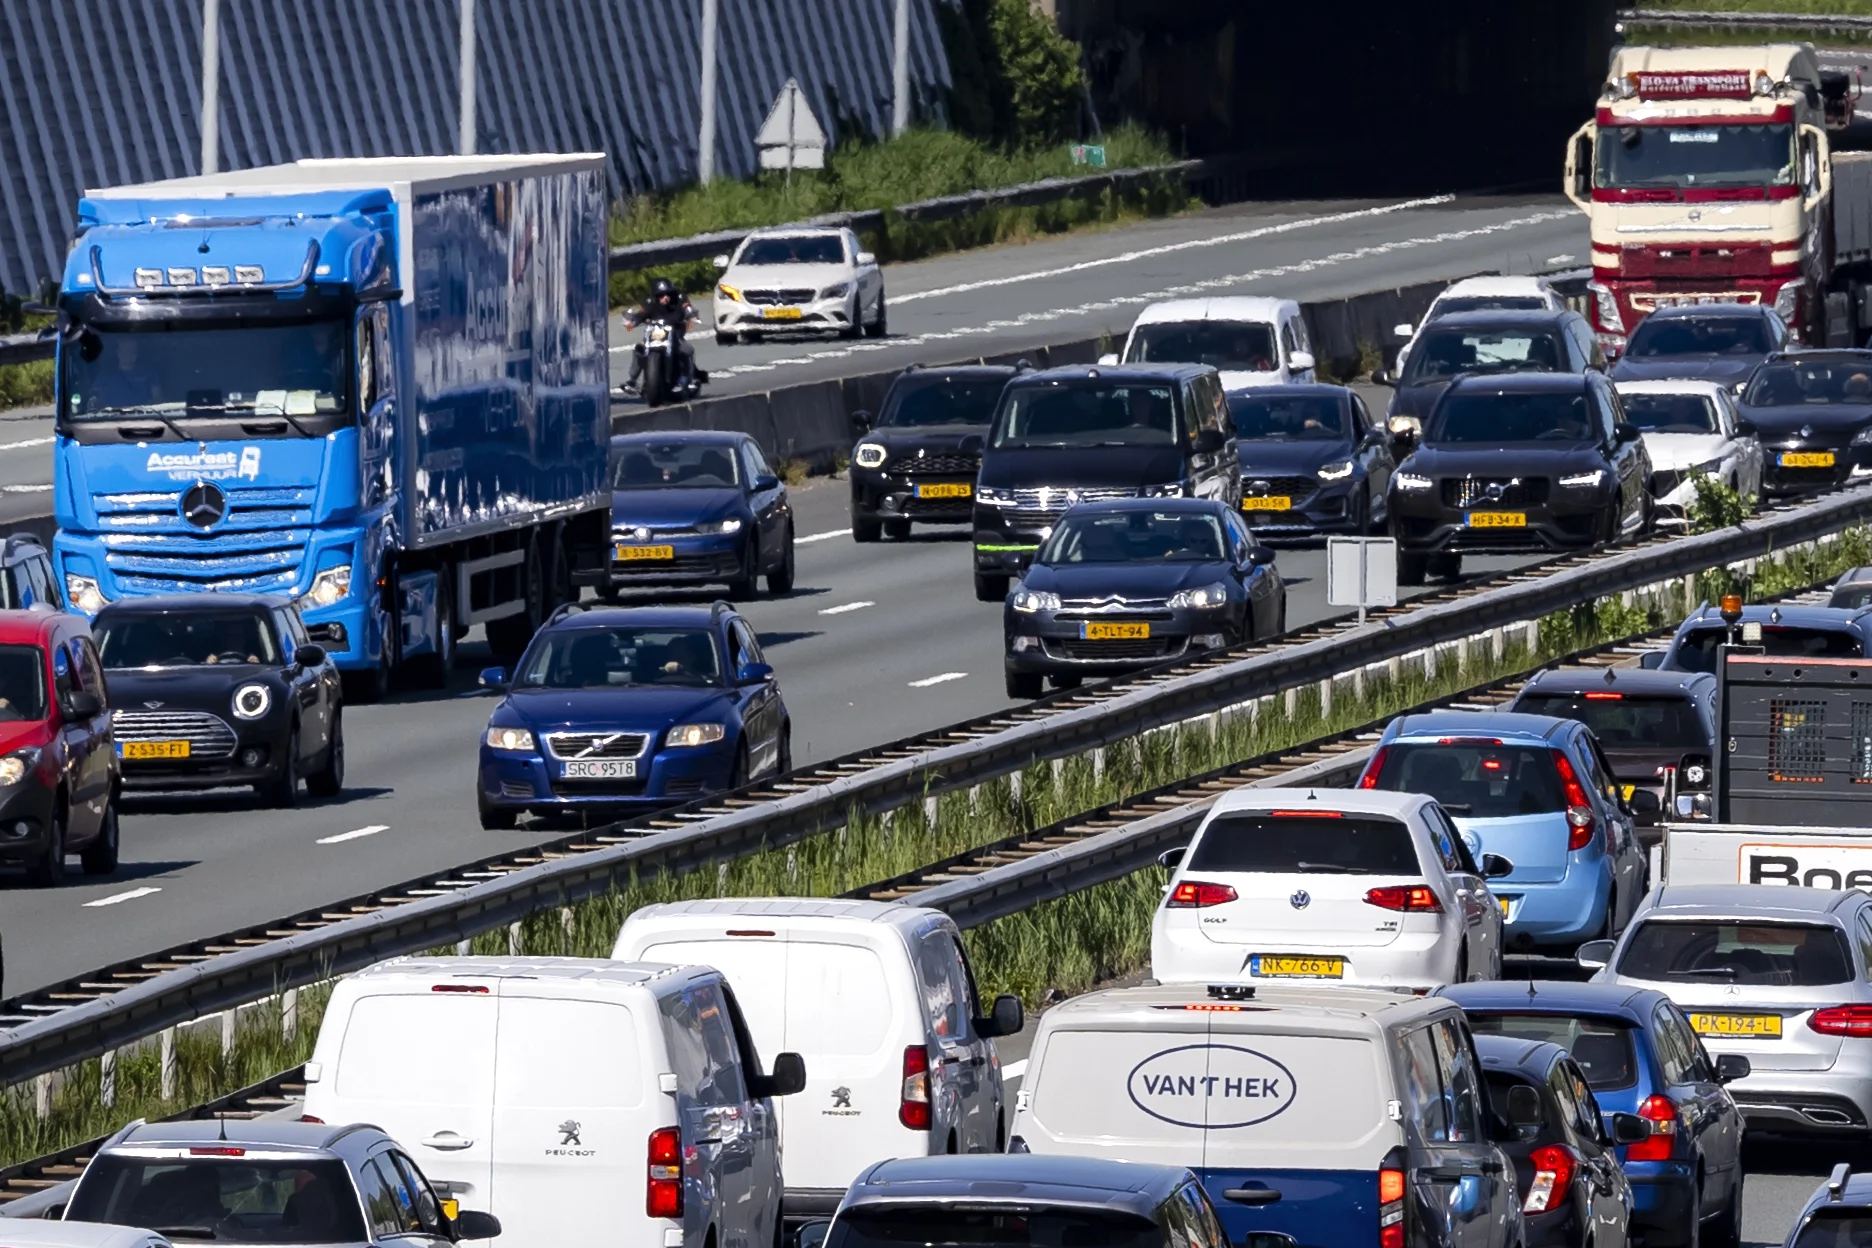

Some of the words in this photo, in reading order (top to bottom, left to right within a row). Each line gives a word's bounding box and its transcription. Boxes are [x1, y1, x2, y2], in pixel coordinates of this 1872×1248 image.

[147, 452, 238, 465] Accuraat
[168, 470, 238, 481] VERHUUR
[1090, 625, 1143, 637] 4-TLT-94
[568, 762, 597, 776] SRC
[601, 762, 634, 777] 95T8
[1262, 956, 1334, 973] NK-766-V
[1698, 1015, 1773, 1033] PK-194-L
[1143, 1074, 1195, 1096] VAN
[1225, 1077, 1279, 1099] HEK
